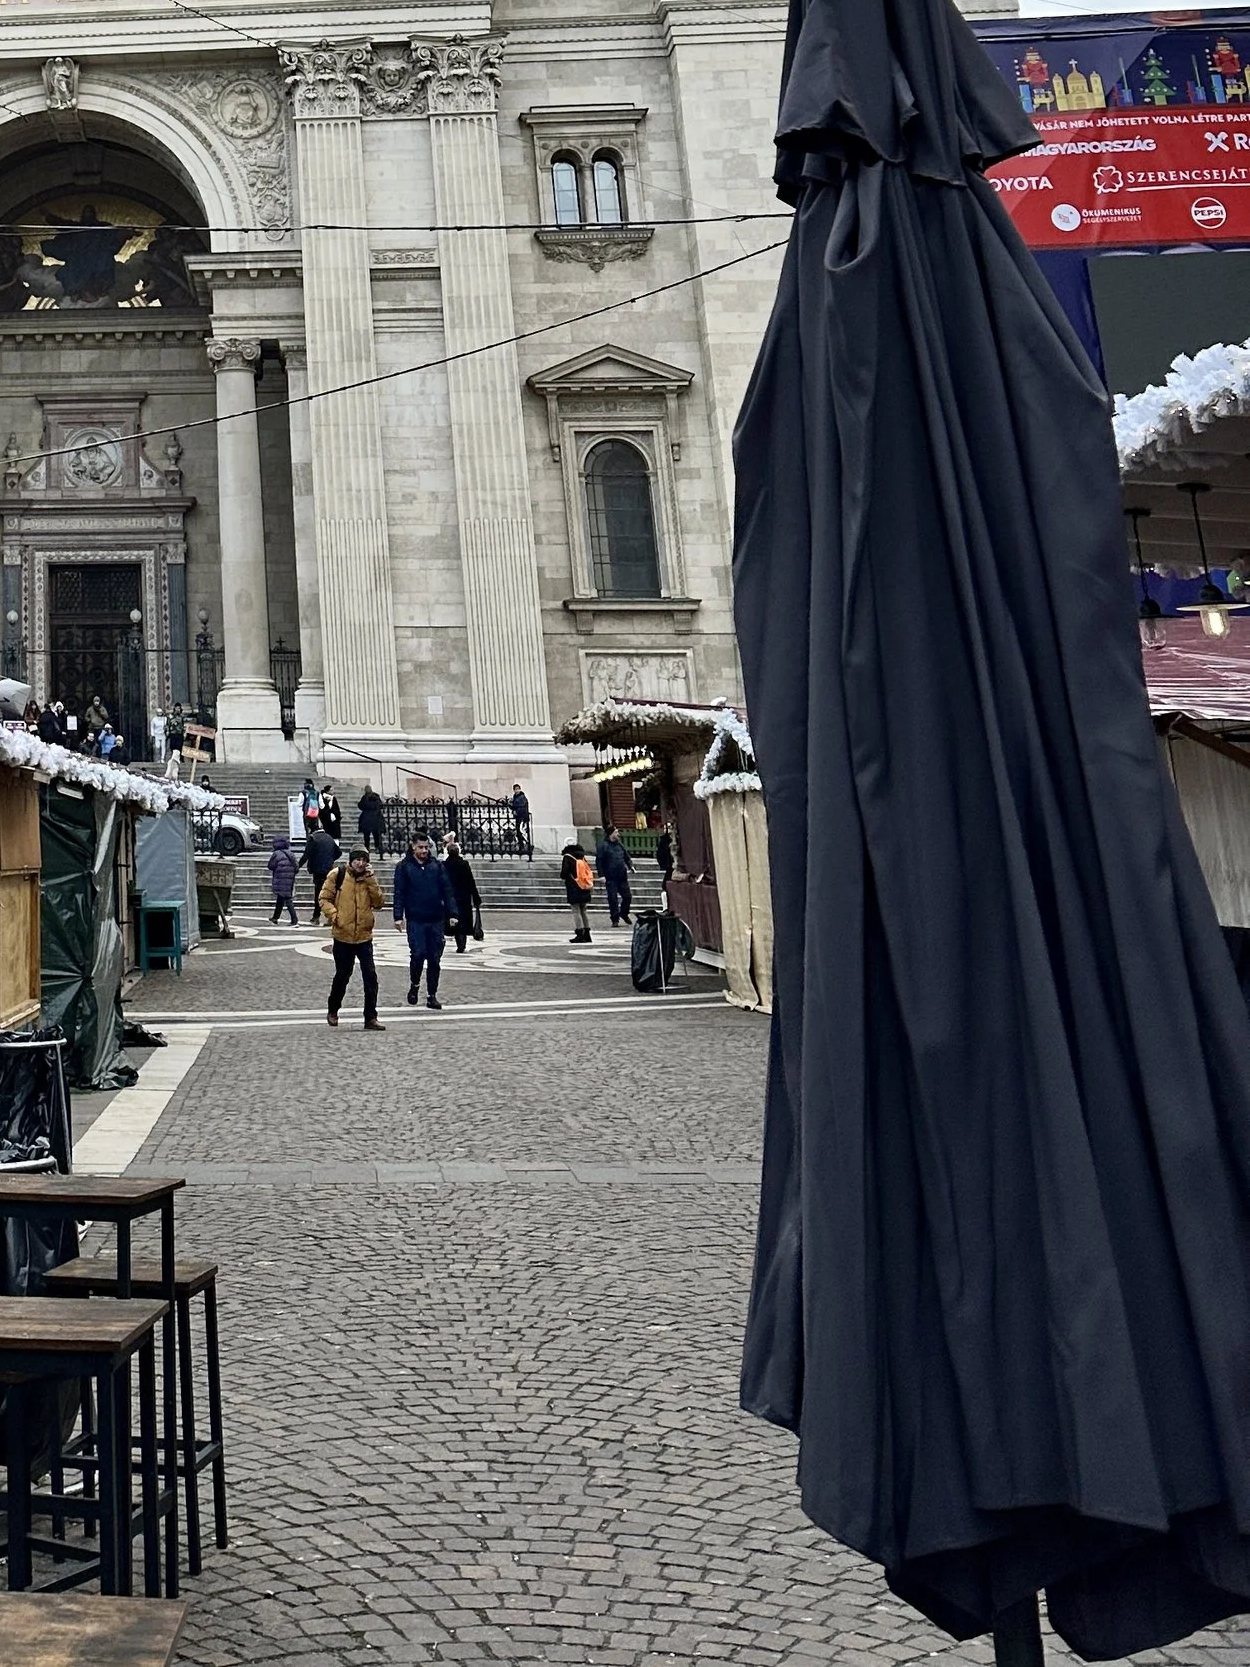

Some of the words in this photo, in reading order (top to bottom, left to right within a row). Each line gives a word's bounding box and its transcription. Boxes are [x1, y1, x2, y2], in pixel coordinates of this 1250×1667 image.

[1070, 120, 1094, 129] NEM
[1152, 115, 1190, 125] VOLNA
[1191, 112, 1225, 123] LÉTRE
[989, 176, 1054, 192] OYOTA
[1081, 207, 1142, 217] ÖKUMENIKUS
